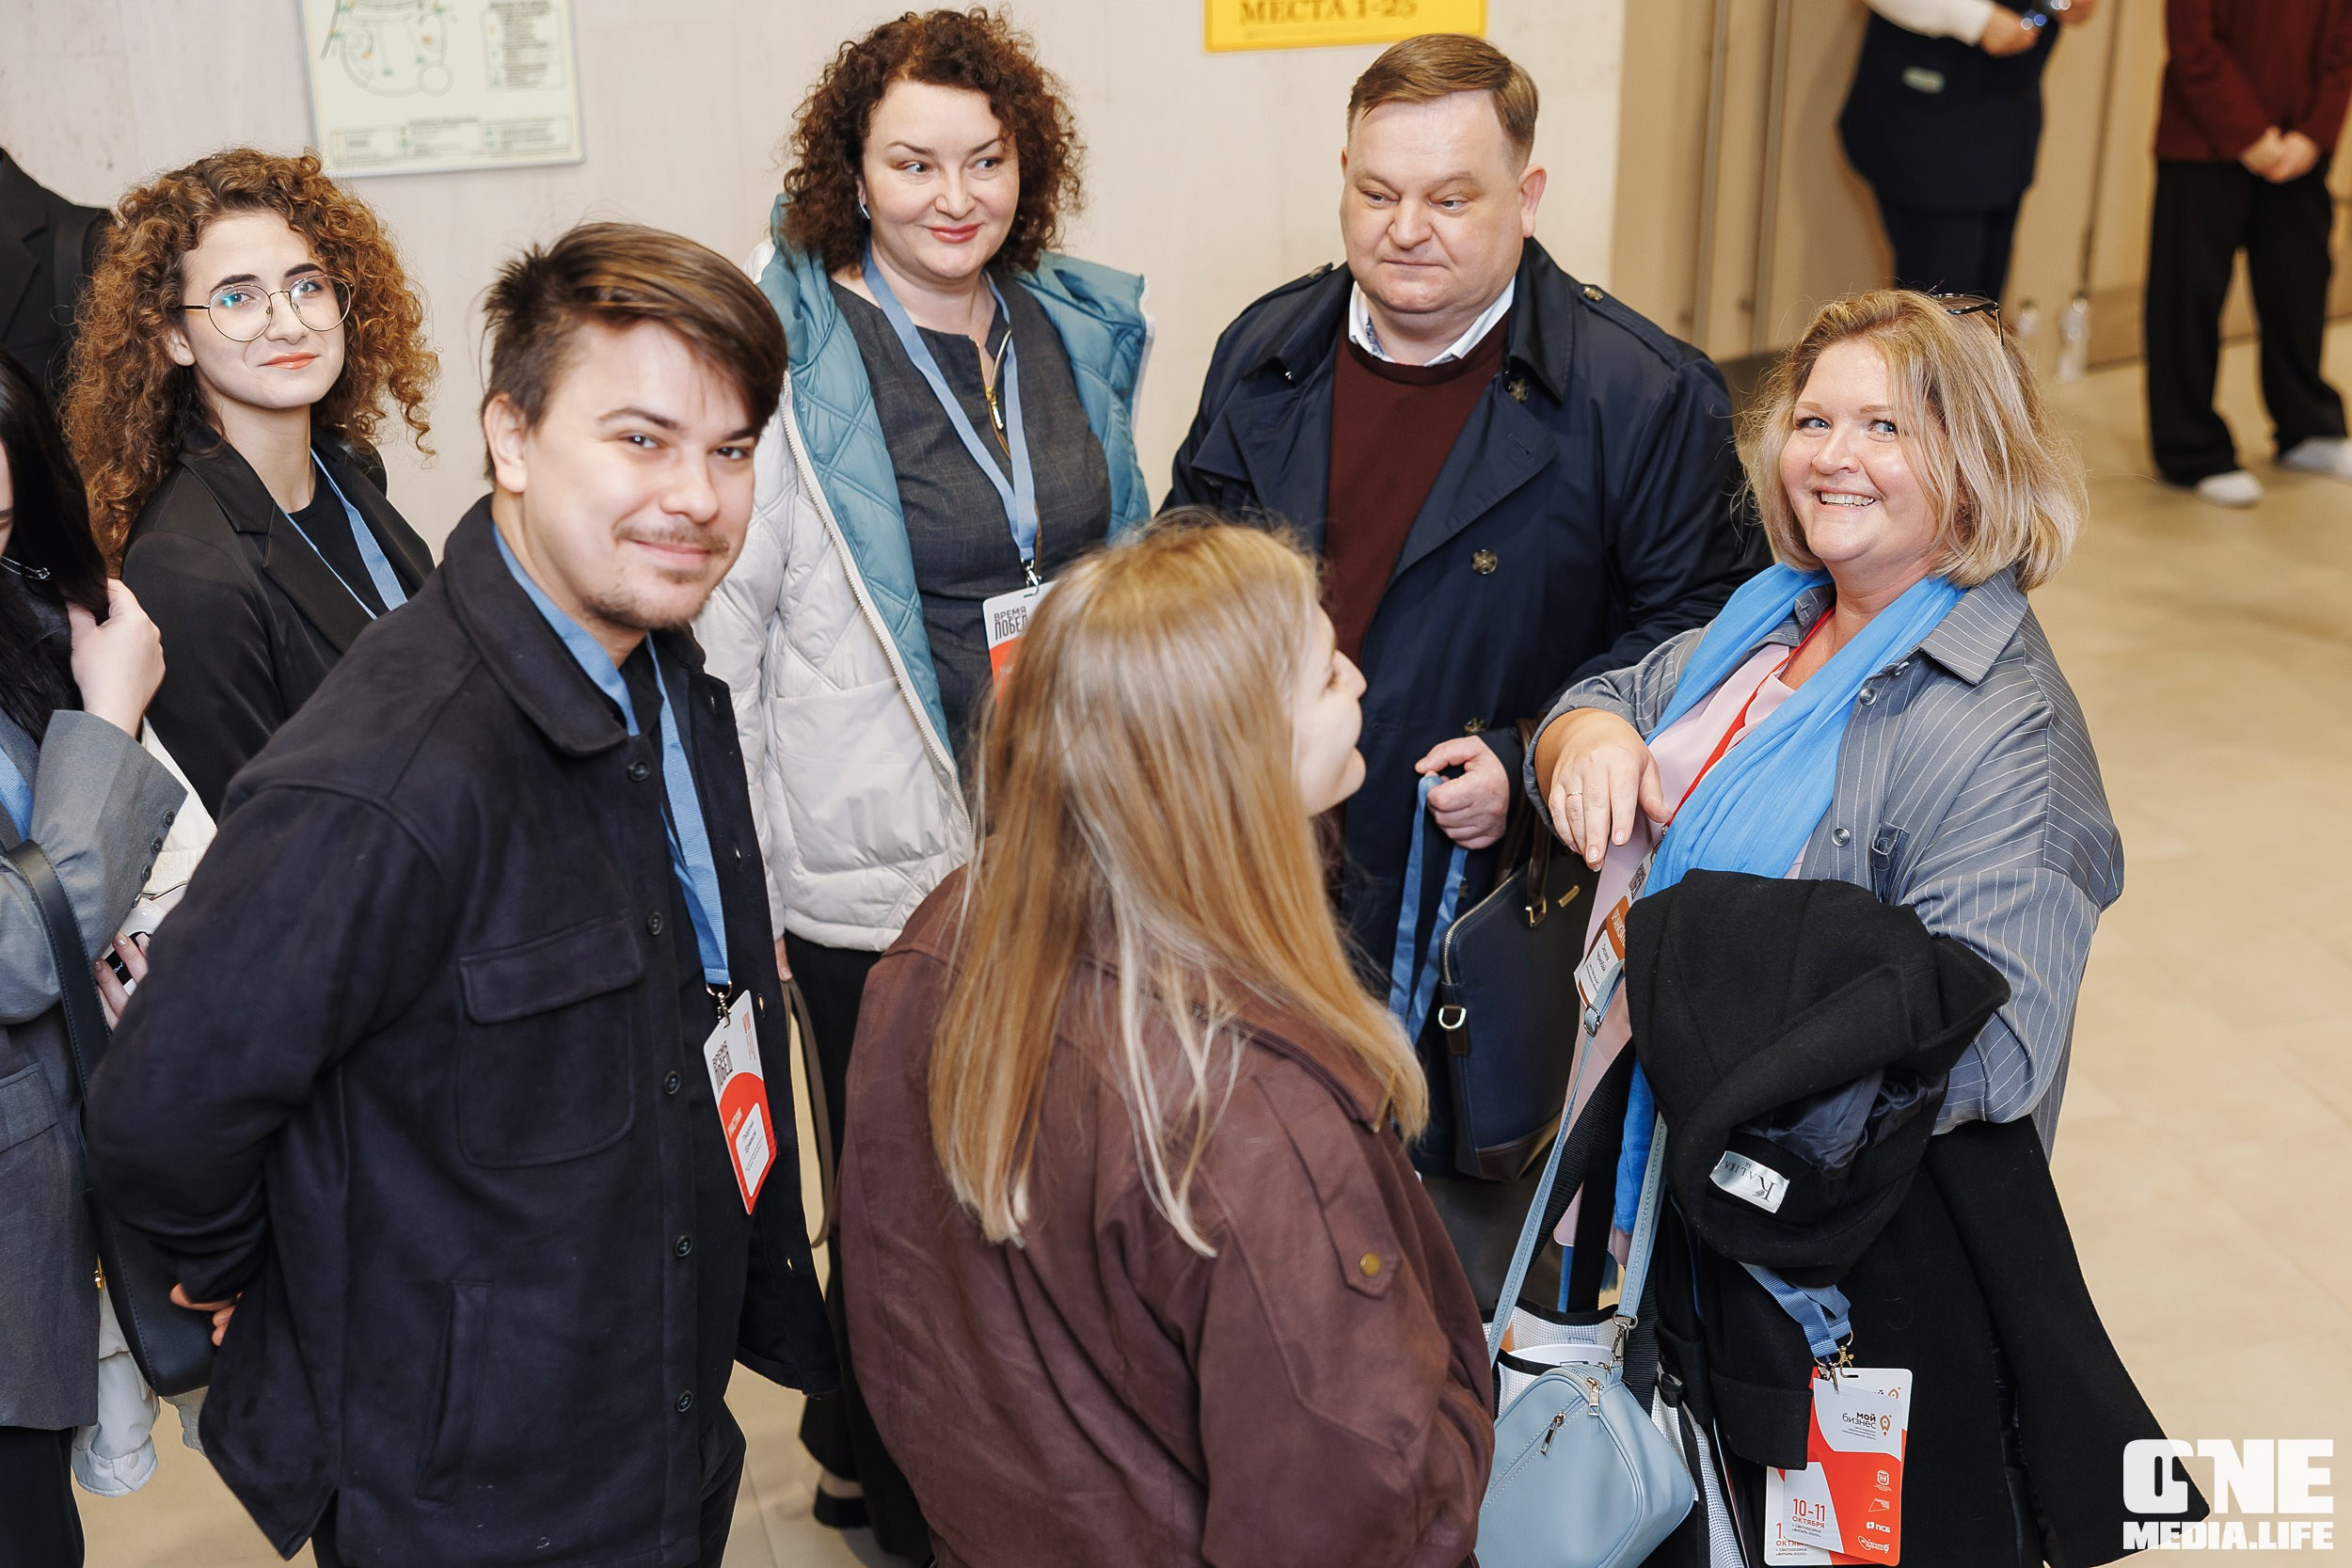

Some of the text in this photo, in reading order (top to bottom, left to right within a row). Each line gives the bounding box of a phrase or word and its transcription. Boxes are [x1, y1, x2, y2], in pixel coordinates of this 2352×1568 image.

[1239, 0, 1346, 24] МЕСТА
[993, 606, 1026, 622] ВРЕМЯ
[1724, 1161, 1778, 1202] KALIKA
[1842, 1413, 1877, 1429] бизнес
[1856, 1412, 1876, 1422] мой
[1792, 1498, 1826, 1521] 10-11
[1792, 1516, 1825, 1528] ОКТЯБРЯ
[1875, 1524, 1891, 1533] ПСБ
